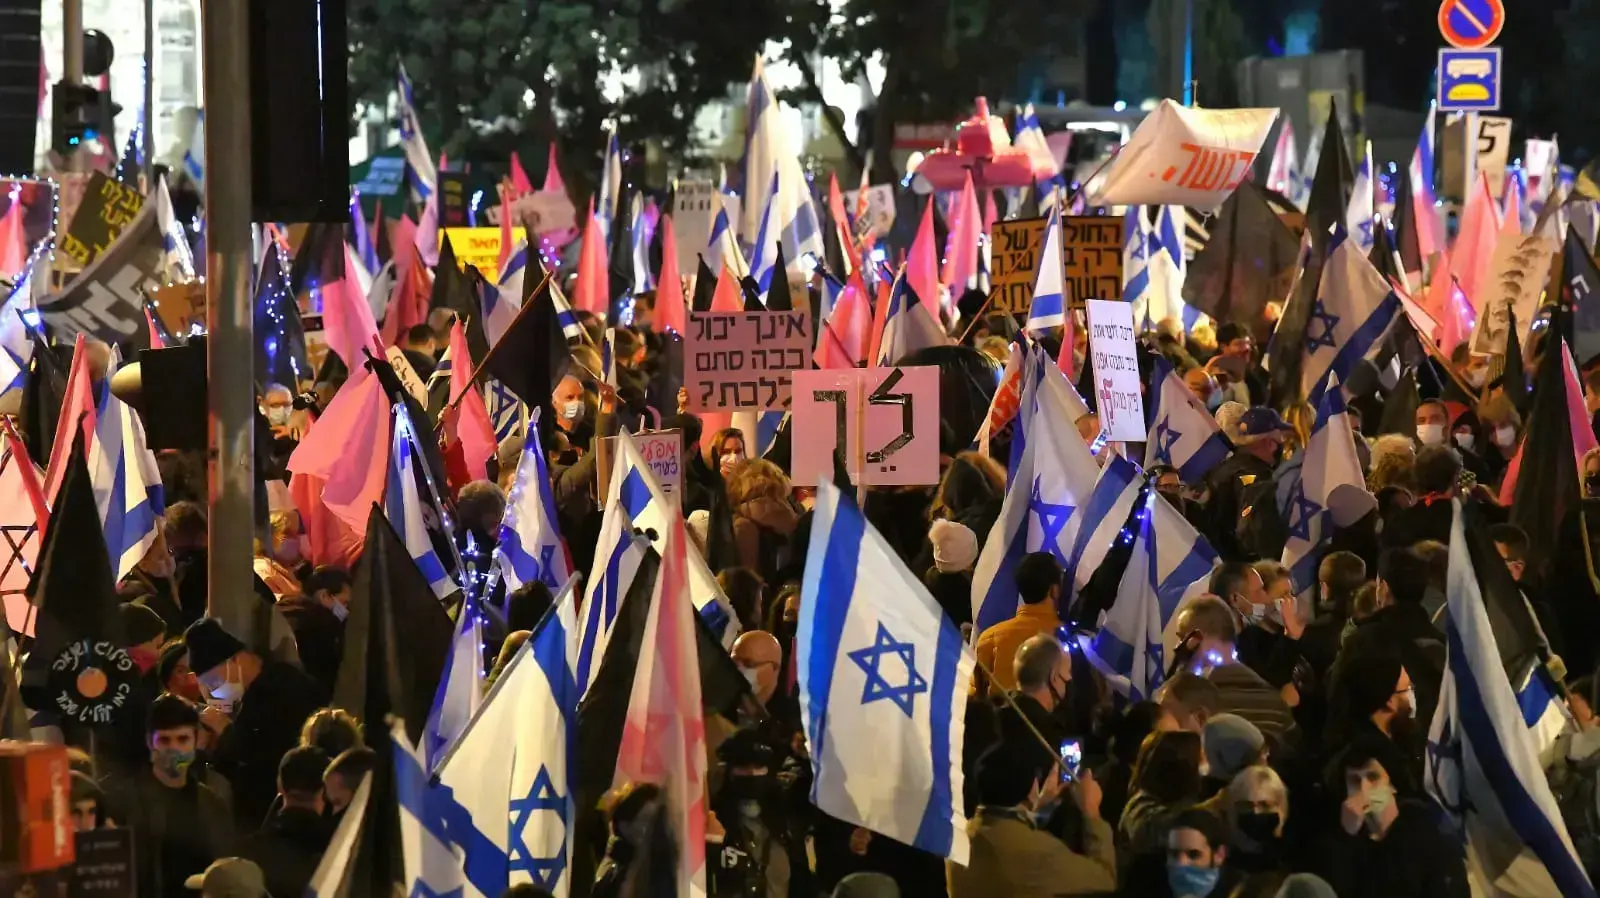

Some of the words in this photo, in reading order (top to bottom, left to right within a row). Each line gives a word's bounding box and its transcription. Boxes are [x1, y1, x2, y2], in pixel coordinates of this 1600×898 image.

[689, 313, 736, 342] יכול
[745, 312, 807, 345] אינך
[695, 350, 744, 372] סתם
[751, 348, 805, 370] ככה
